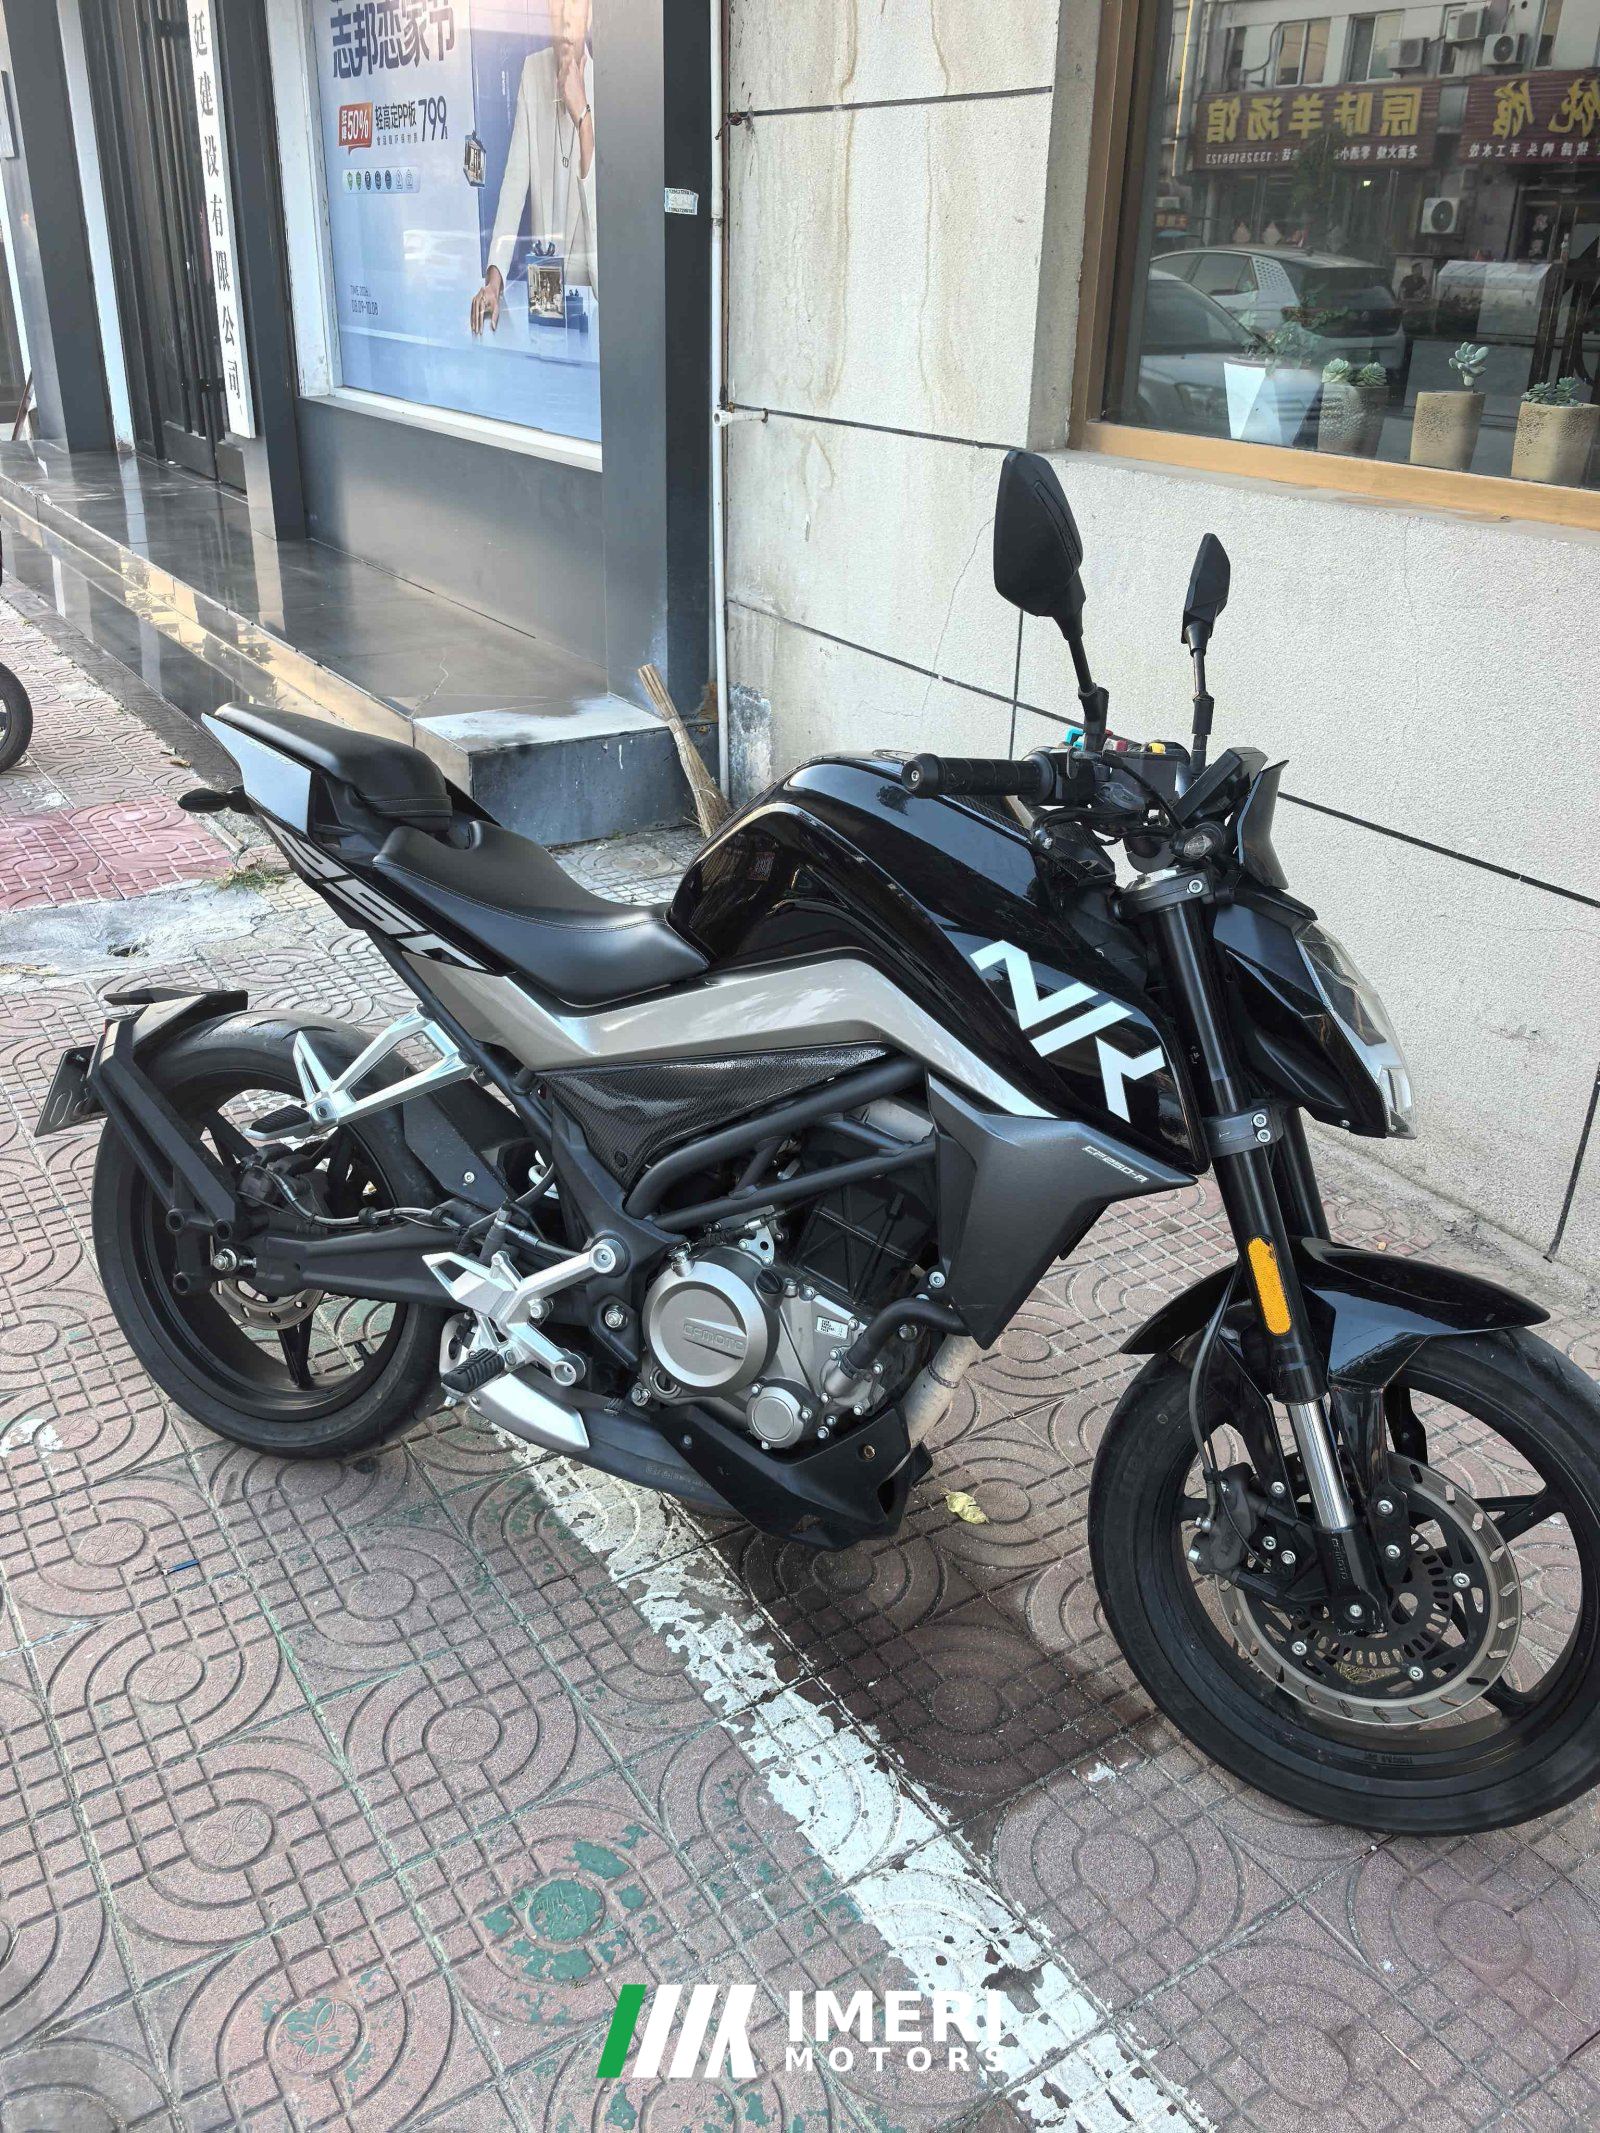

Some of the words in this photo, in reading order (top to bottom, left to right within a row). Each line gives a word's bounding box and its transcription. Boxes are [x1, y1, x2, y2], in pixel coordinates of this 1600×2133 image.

[330, 0, 455, 79] 志邦恋家节
[346, 109, 369, 141] 50%
